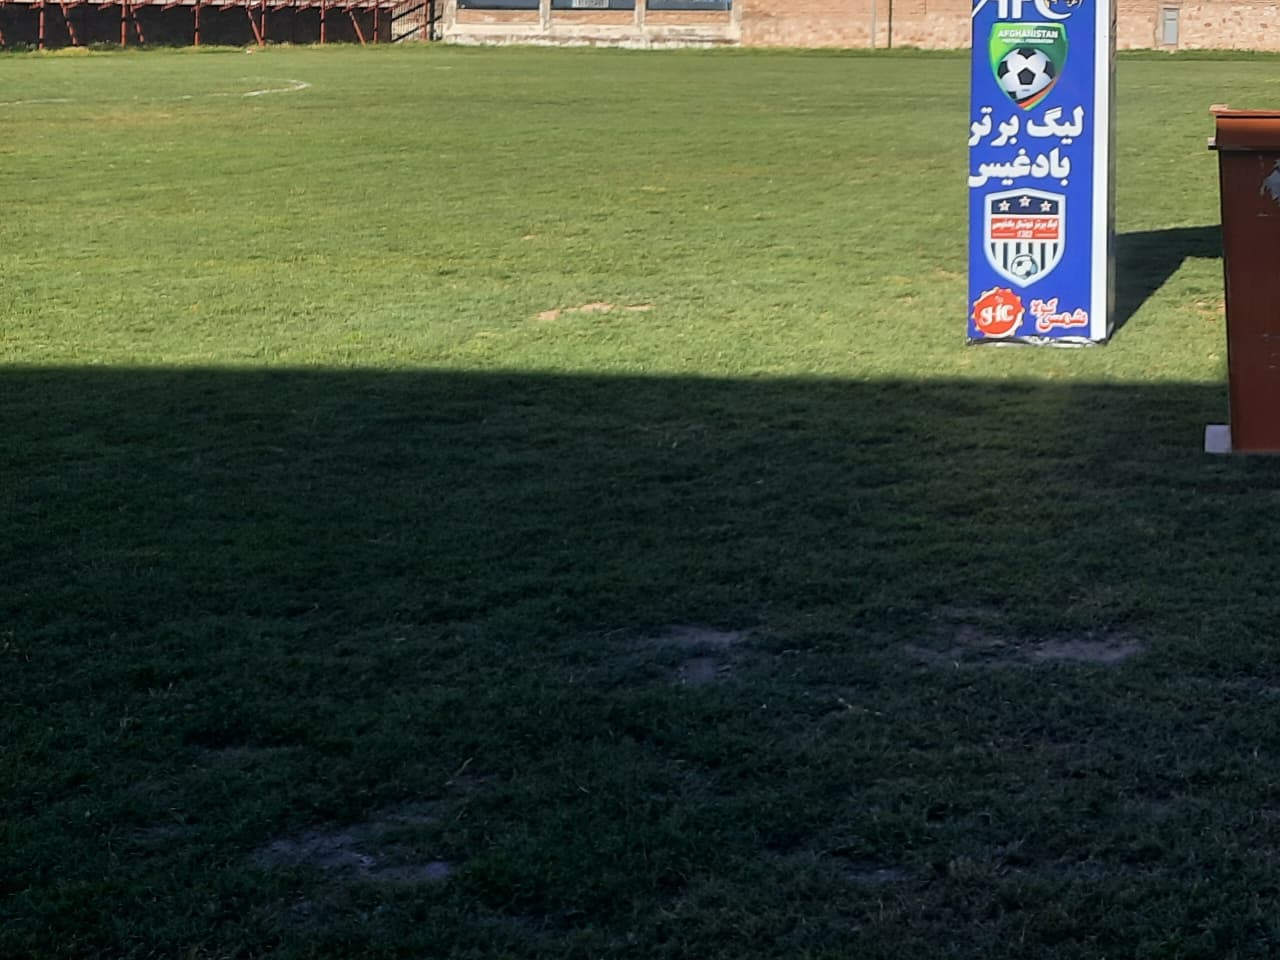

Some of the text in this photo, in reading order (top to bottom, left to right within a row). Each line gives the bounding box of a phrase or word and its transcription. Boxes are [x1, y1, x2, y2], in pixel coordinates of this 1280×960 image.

[998, 29, 1059, 39] AFGHANISTAN
[968, 105, 1085, 146] لیگ برتر
[968, 147, 1071, 188] بادغیس
